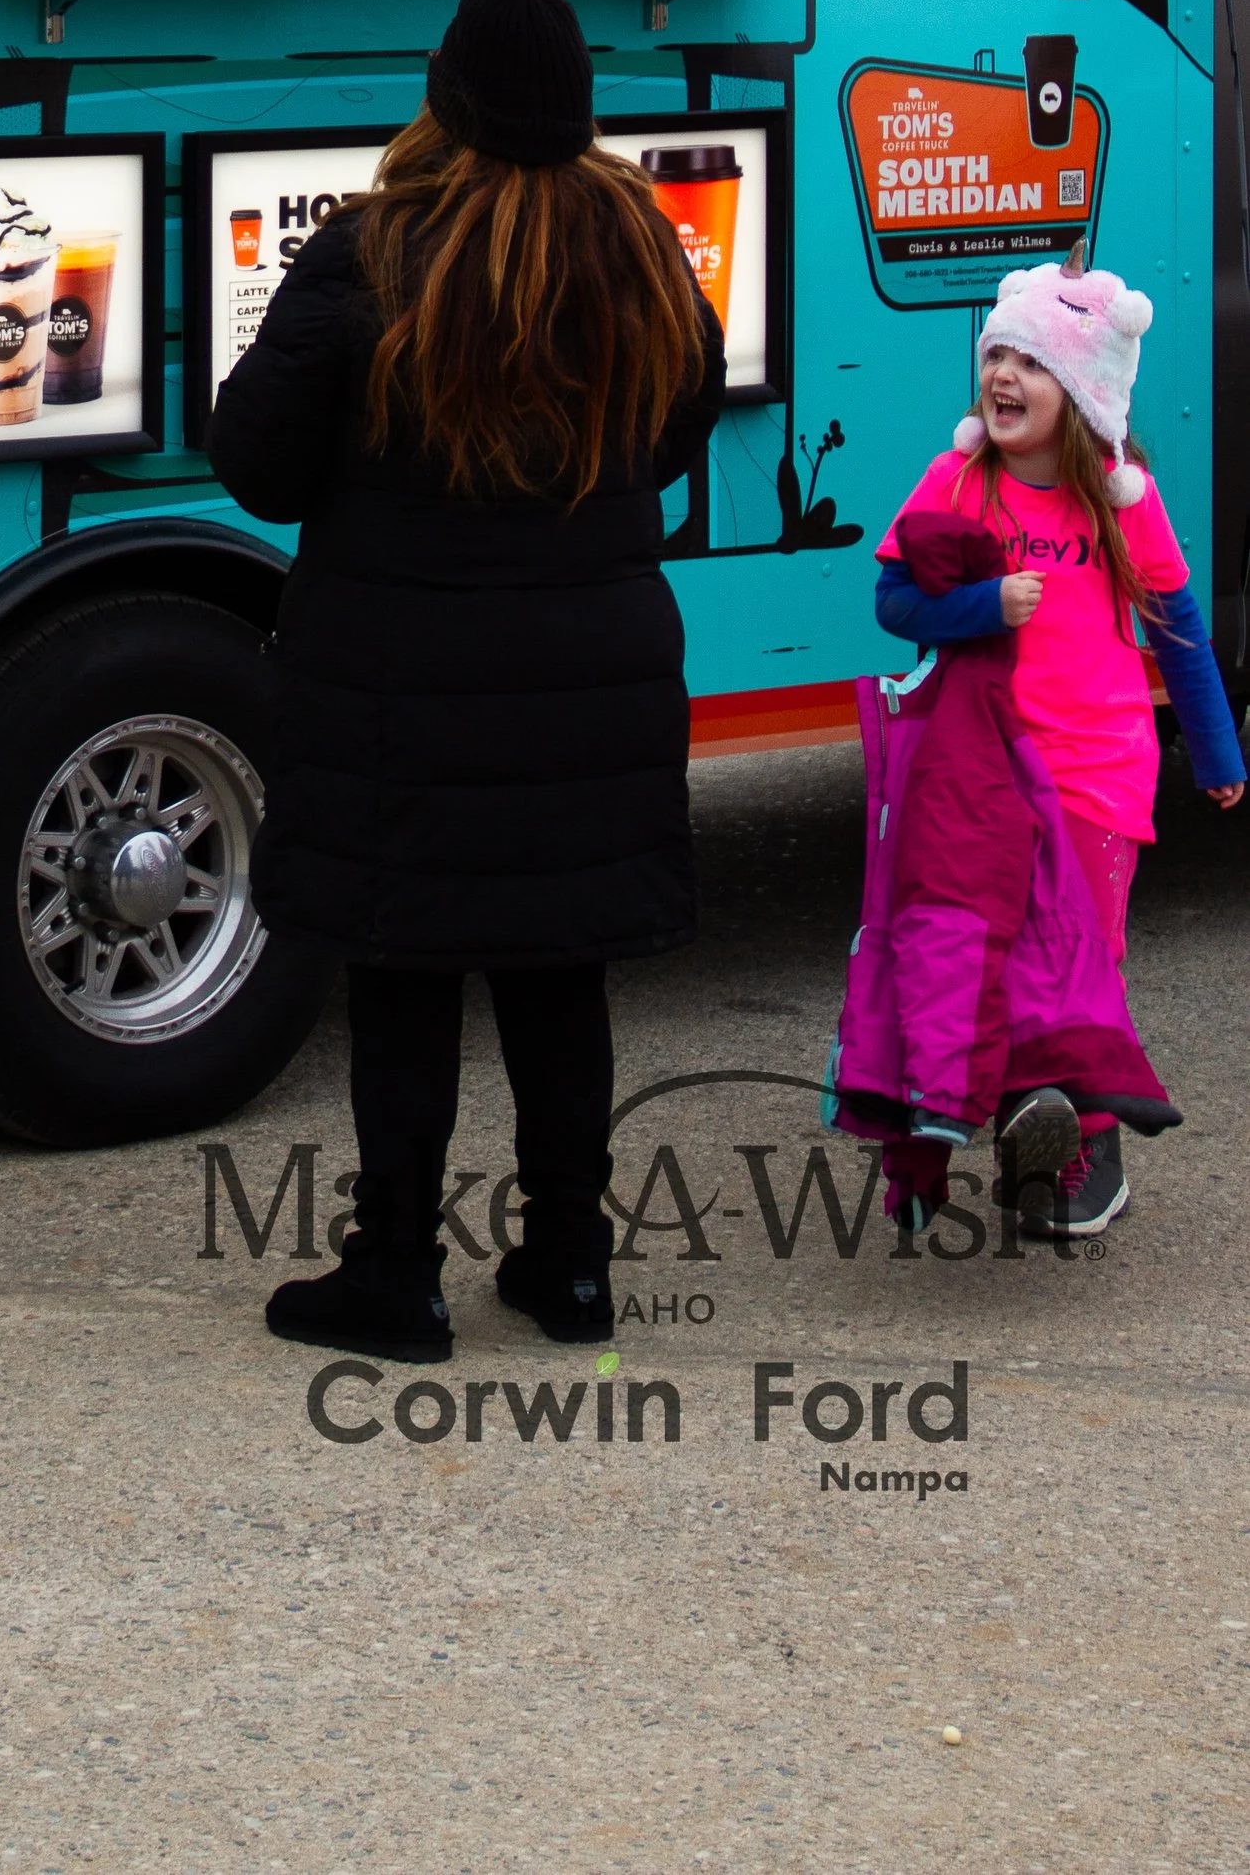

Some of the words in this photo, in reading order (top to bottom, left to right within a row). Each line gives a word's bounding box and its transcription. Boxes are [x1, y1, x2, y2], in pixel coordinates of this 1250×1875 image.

[893, 101, 939, 112] TRAVELIN'
[878, 112, 954, 140] TOM'S
[882, 141, 915, 152] COFFEE
[920, 140, 949, 151] TRUCK
[878, 155, 989, 188] SOUTH
[878, 182, 1042, 219] MERIDIAN
[236, 239, 258, 247] TOM'S
[909, 241, 943, 253] Chris
[949, 241, 957, 251] &
[964, 238, 1005, 251] Leslie
[1011, 235, 1052, 247] Wilmes
[237, 287, 269, 297] LATTE
[237, 307, 268, 316] CAPP
[48, 319, 89, 334] TOM'S
